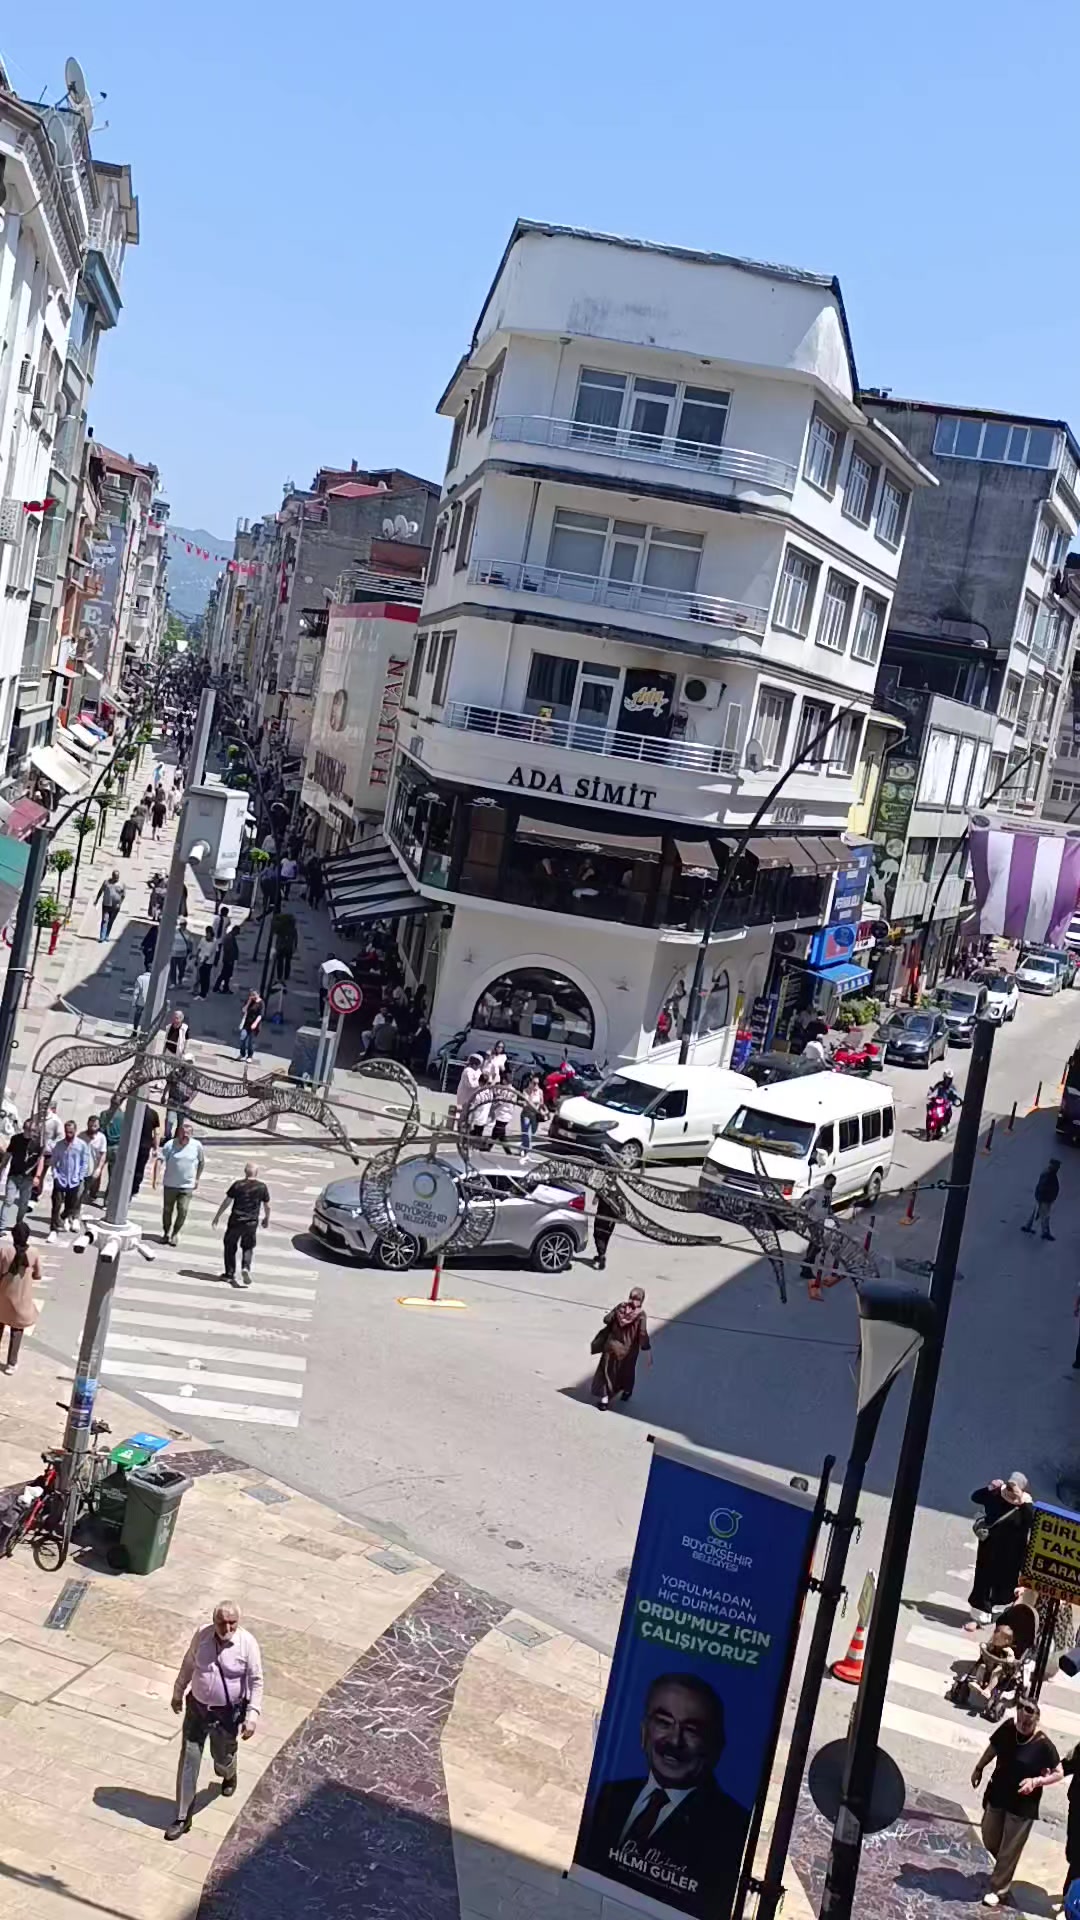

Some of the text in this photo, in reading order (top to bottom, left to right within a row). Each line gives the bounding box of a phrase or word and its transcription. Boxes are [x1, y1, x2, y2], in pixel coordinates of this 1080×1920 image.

[507, 765, 657, 810] ADA SİMİT
[681, 1535, 753, 1568] BÜYÜKŞEHİR
[706, 1535, 733, 1550] ORDU
[661, 1573, 753, 1611] YORULMADAN,
[681, 1595, 757, 1625] DURMADAN
[638, 1599, 730, 1638] ORDU'MUZ
[641, 1621, 760, 1665] ÇALIŞIYORUZ
